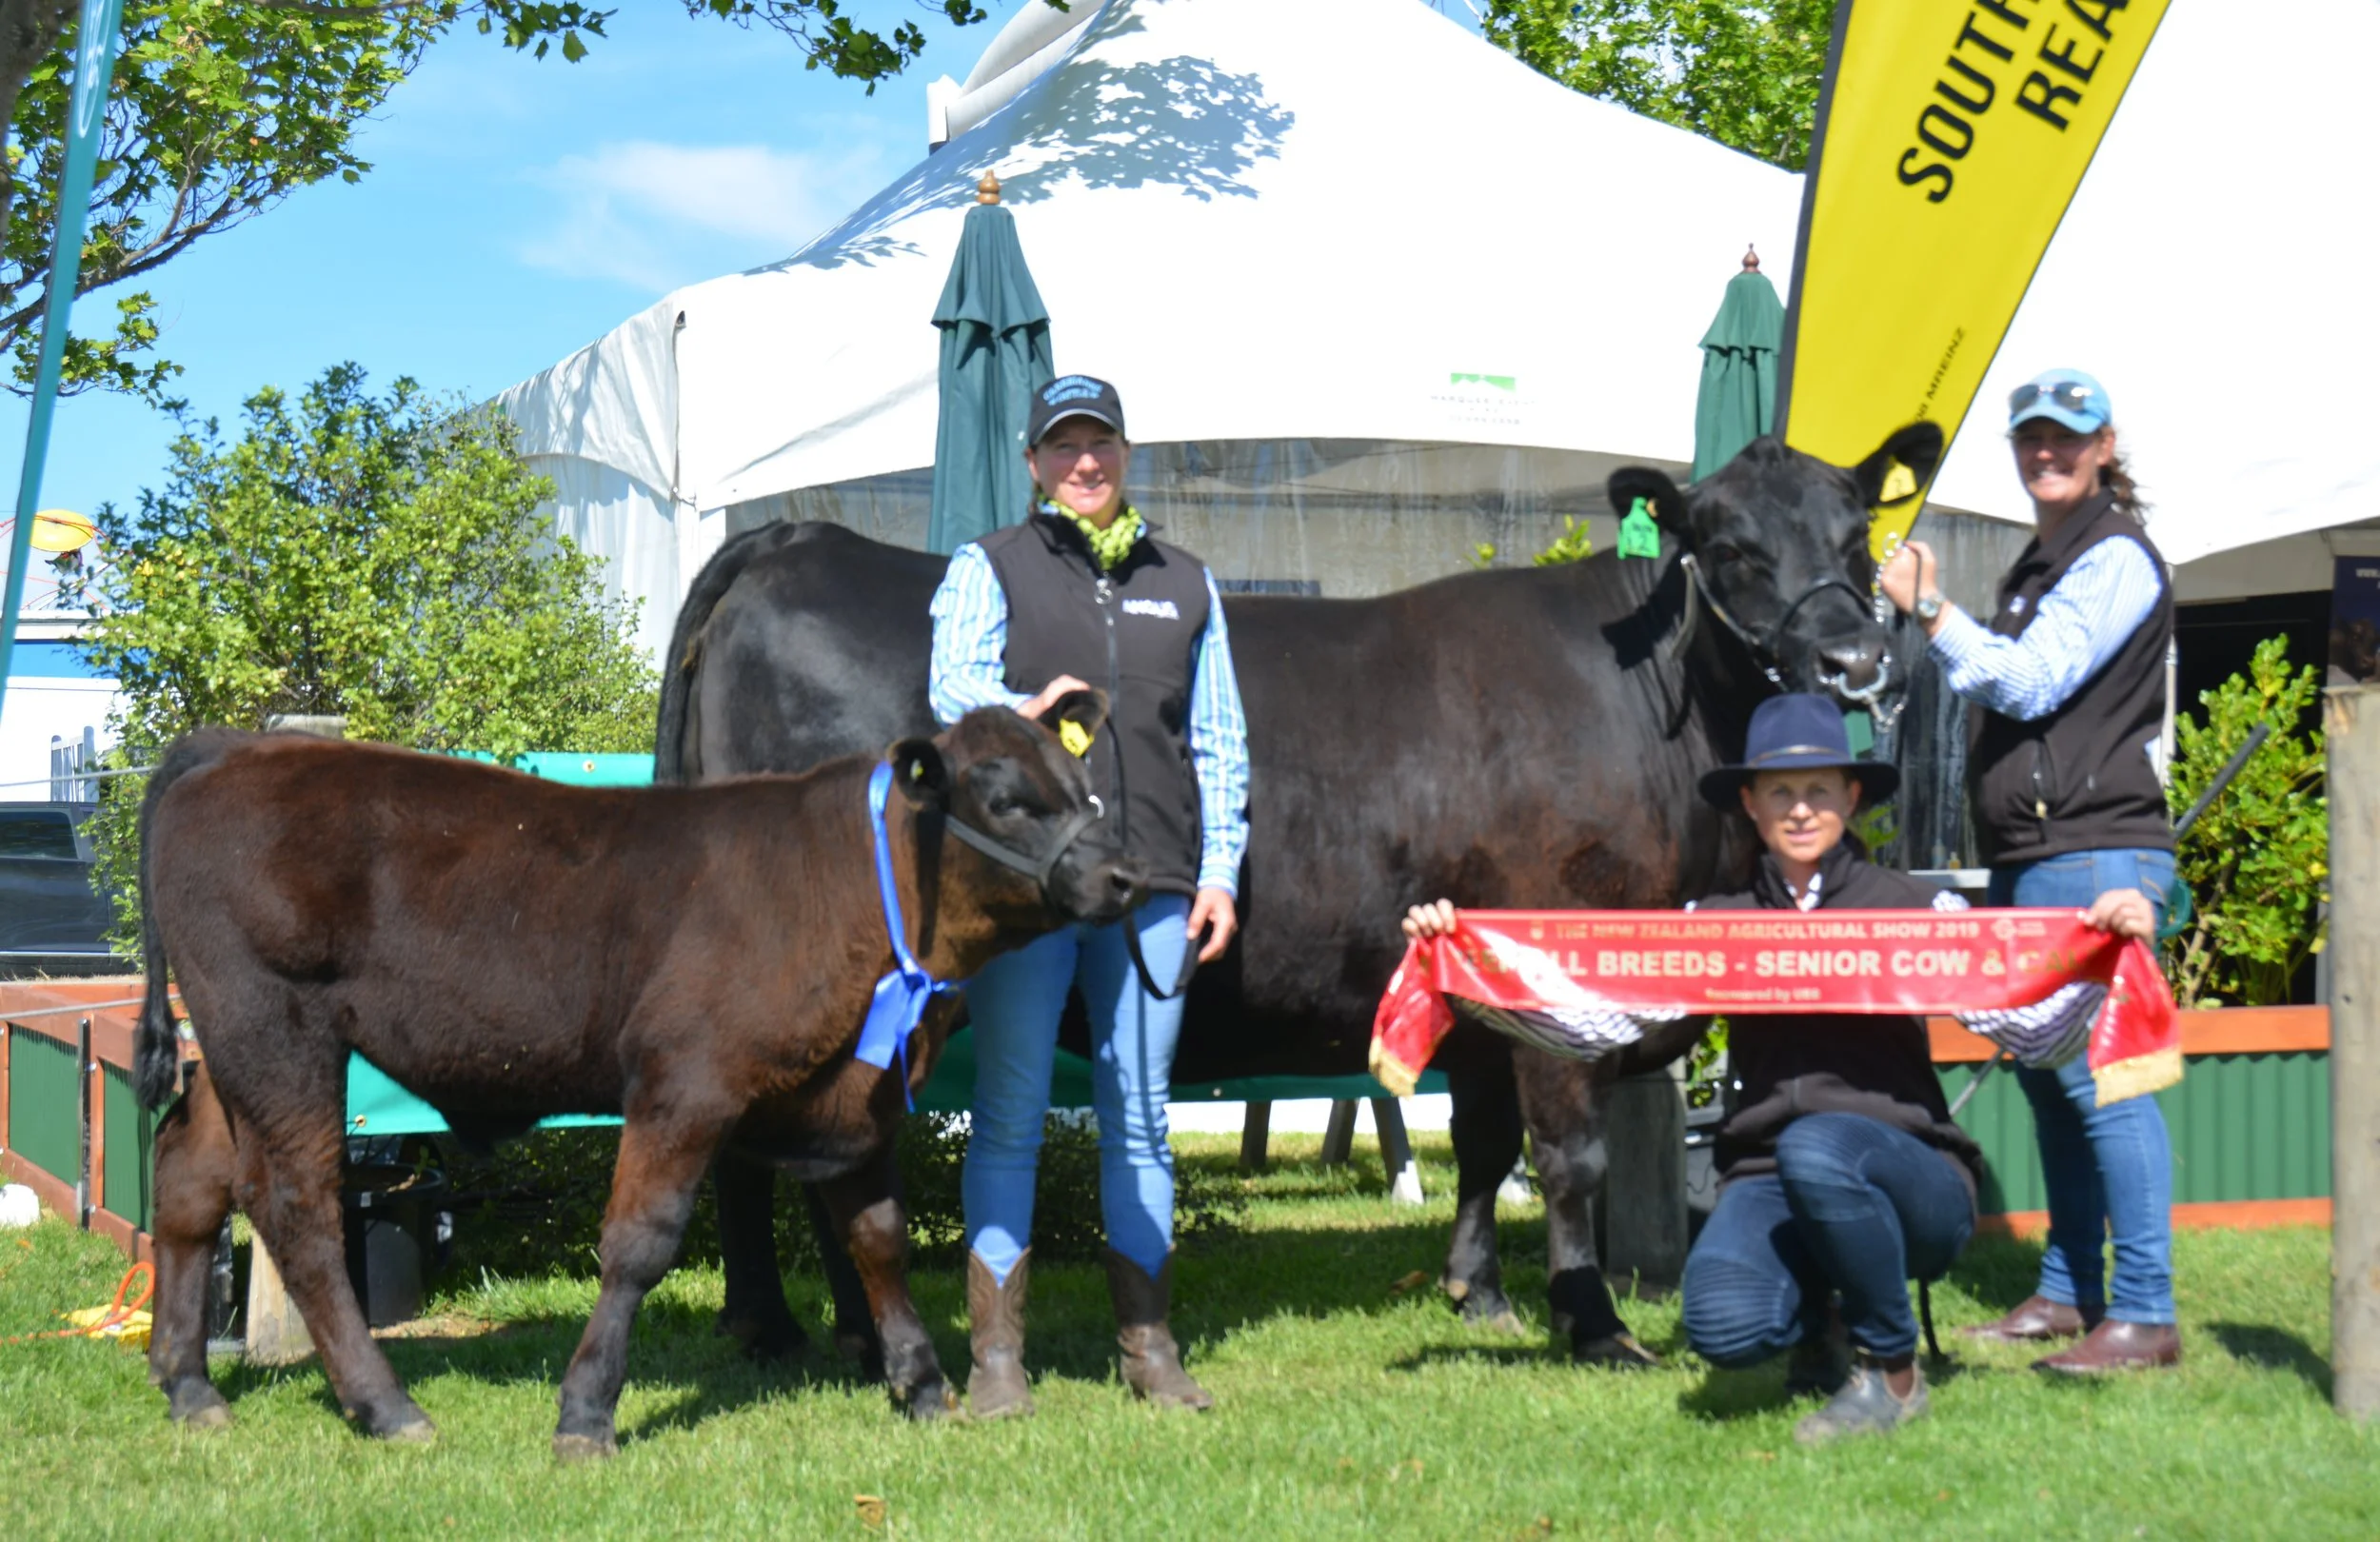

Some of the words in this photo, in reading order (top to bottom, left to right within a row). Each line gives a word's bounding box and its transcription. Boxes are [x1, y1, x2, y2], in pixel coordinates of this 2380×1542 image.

[1556, 923, 1587, 939] THE
[1593, 922, 1635, 939] NEW
[1639, 922, 1724, 939] ZEALAND
[1727, 921, 1868, 939] AGRICULTURAL
[1872, 921, 1932, 939] SHOW
[1934, 921, 1980, 939] 2019
[1597, 950, 1728, 978] BREEDS
[1754, 949, 1882, 978] SENIOR
[1890, 948, 1972, 977] COW
[1980, 949, 2007, 977] &
